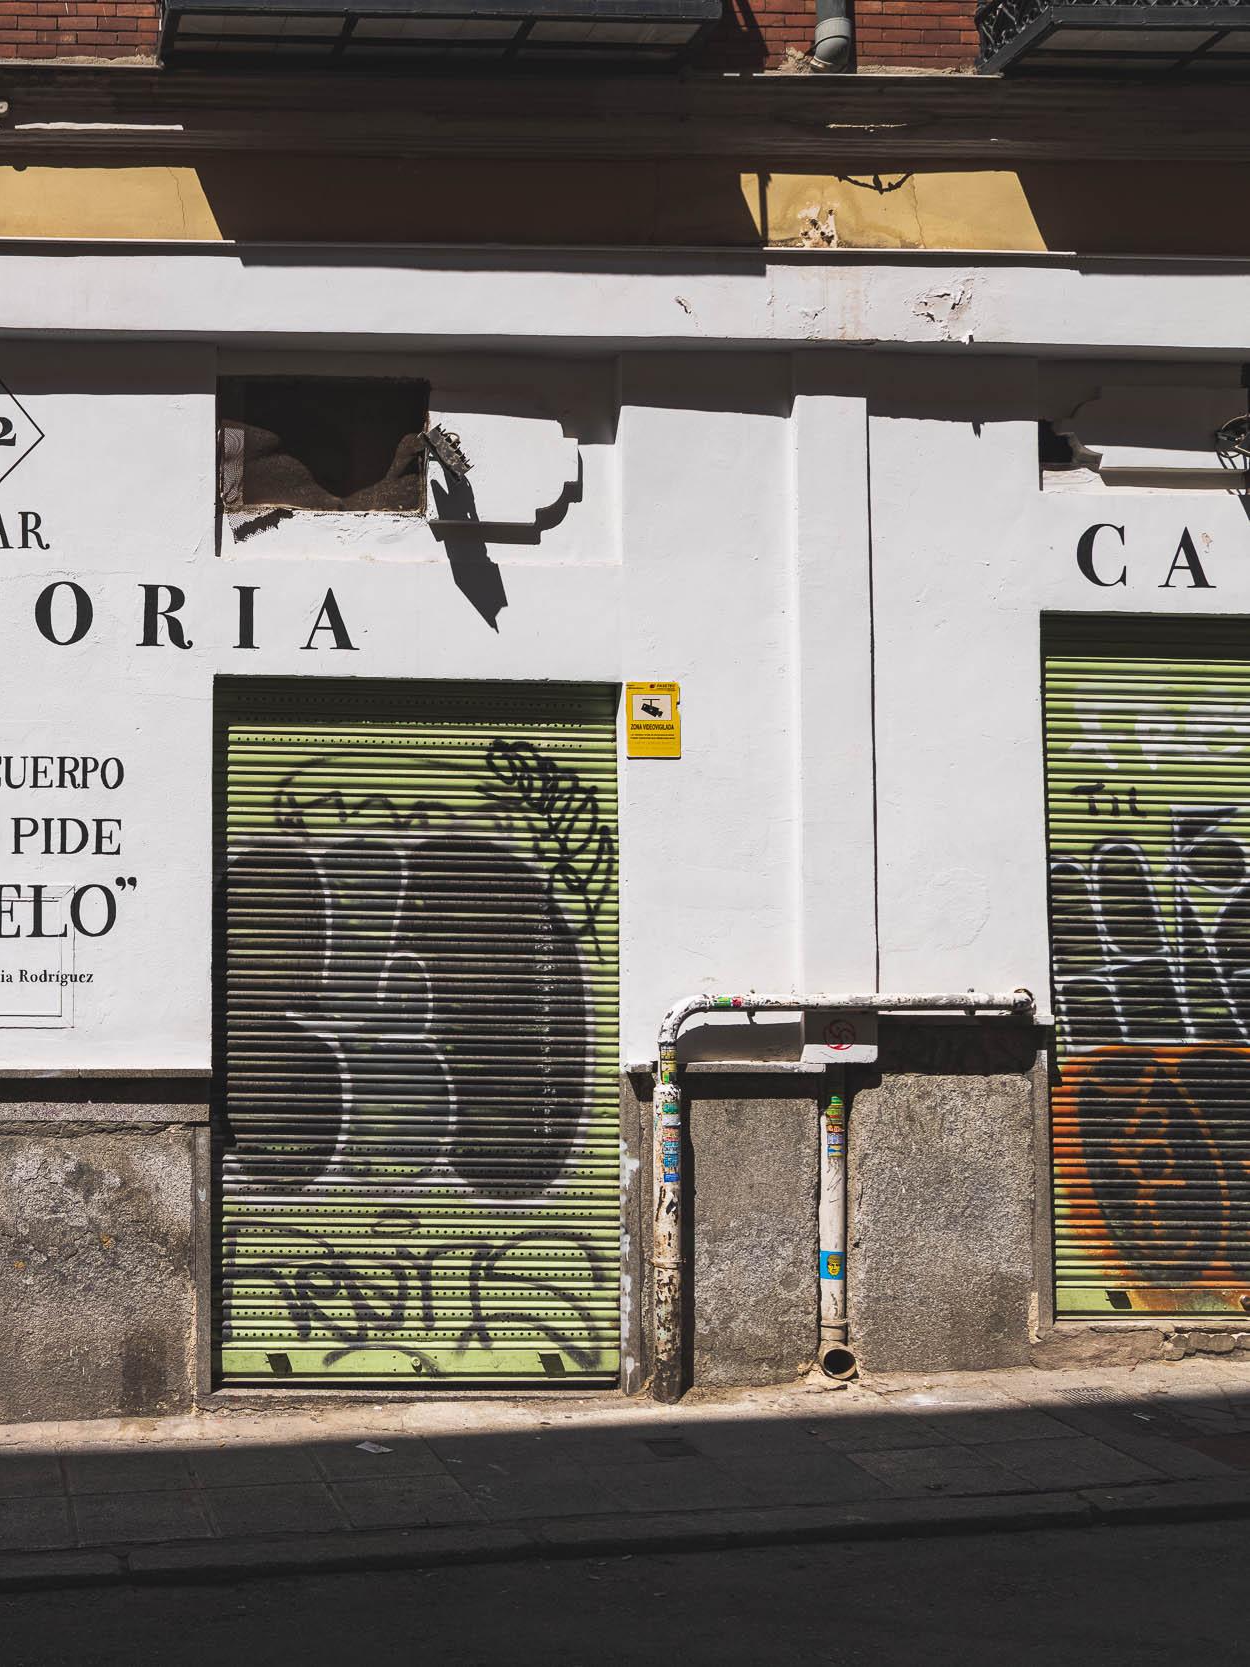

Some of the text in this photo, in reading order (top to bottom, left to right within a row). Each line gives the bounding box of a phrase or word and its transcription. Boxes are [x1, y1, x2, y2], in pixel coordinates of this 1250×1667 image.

[1077, 523, 1217, 589] CA
[631, 723, 675, 731] ZONA VIDEOVIGILADA
[10, 817, 122, 856] PIDE
[19, 969, 94, 987] Rodríguez
